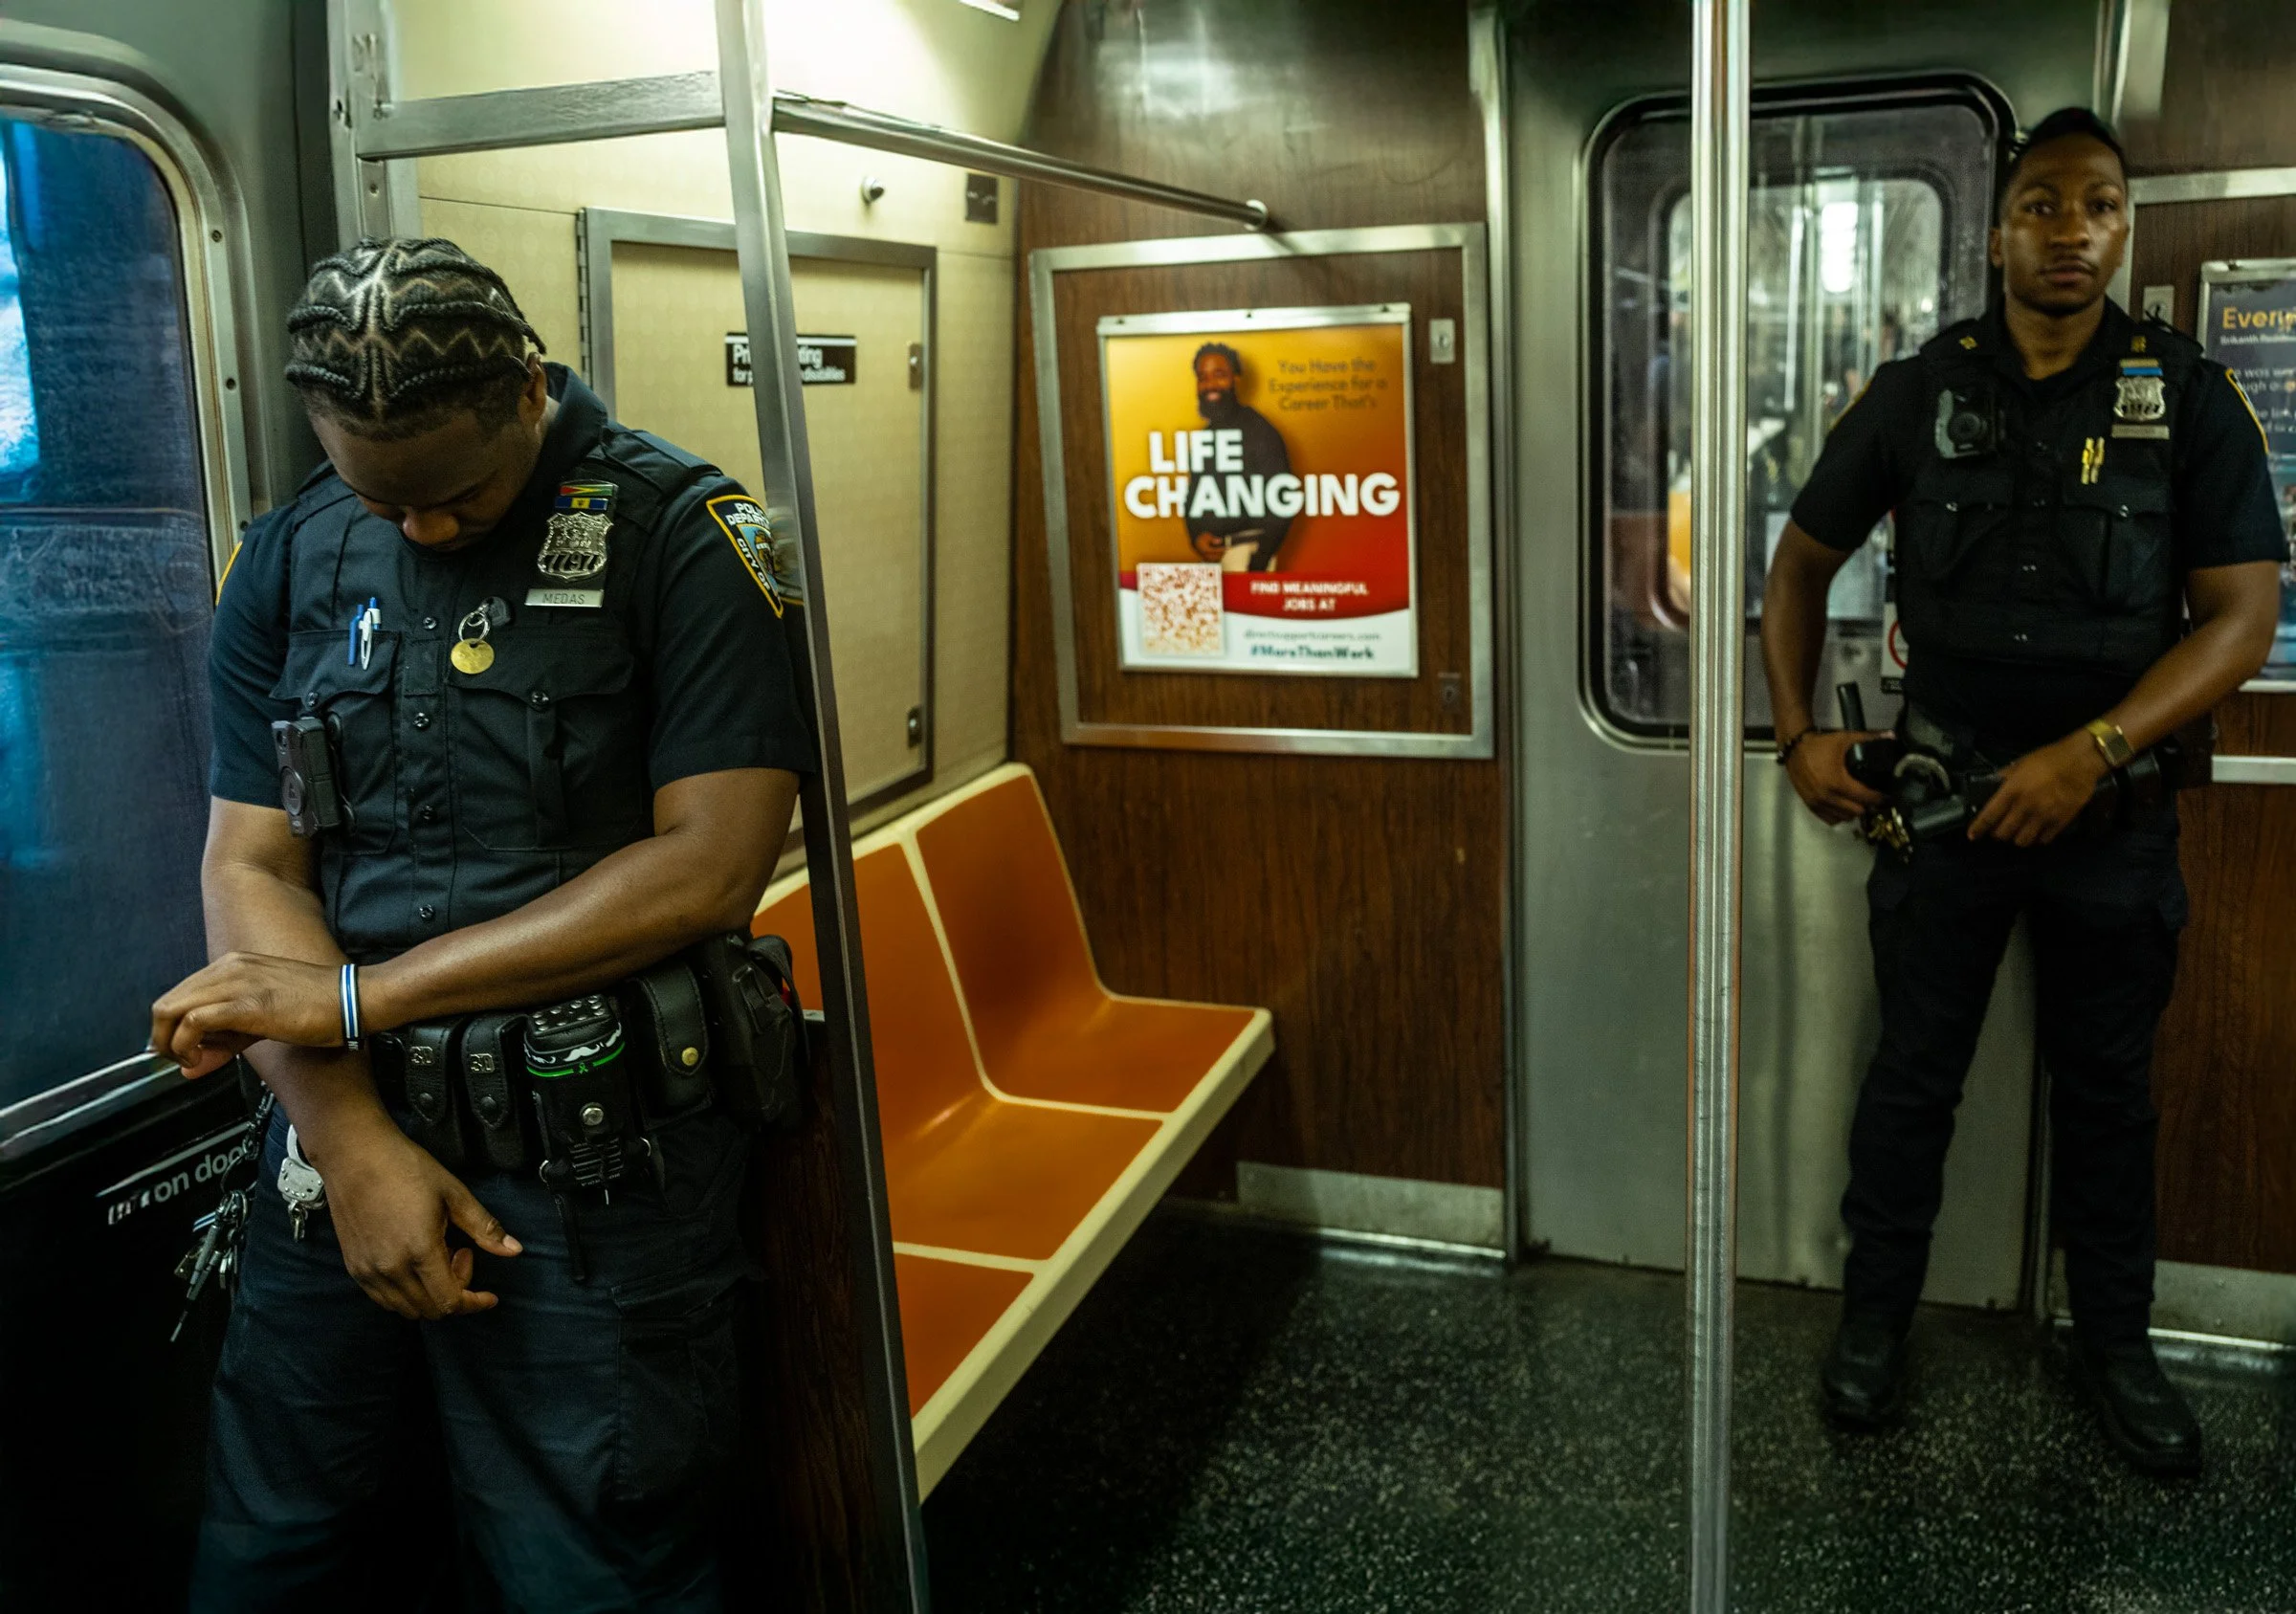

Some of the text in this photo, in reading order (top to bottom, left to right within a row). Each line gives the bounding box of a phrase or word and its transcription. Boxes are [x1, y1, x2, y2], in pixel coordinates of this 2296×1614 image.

[1277, 357, 1376, 373] You Have the
[1269, 375, 1386, 393] Experience for a
[1278, 394, 1377, 410] Career That's
[1148, 428, 1244, 474] LIFE
[1124, 473, 1402, 519] CHANGING
[737, 538, 771, 590] CITY OF
[1250, 580, 1369, 595] FIND MEANINGFUL
[542, 593, 585, 605] MEDAS
[1283, 597, 1336, 611] JOBS AT
[1250, 644, 1375, 659] #MoreThanWork
[153, 1146, 245, 1203] on doo
